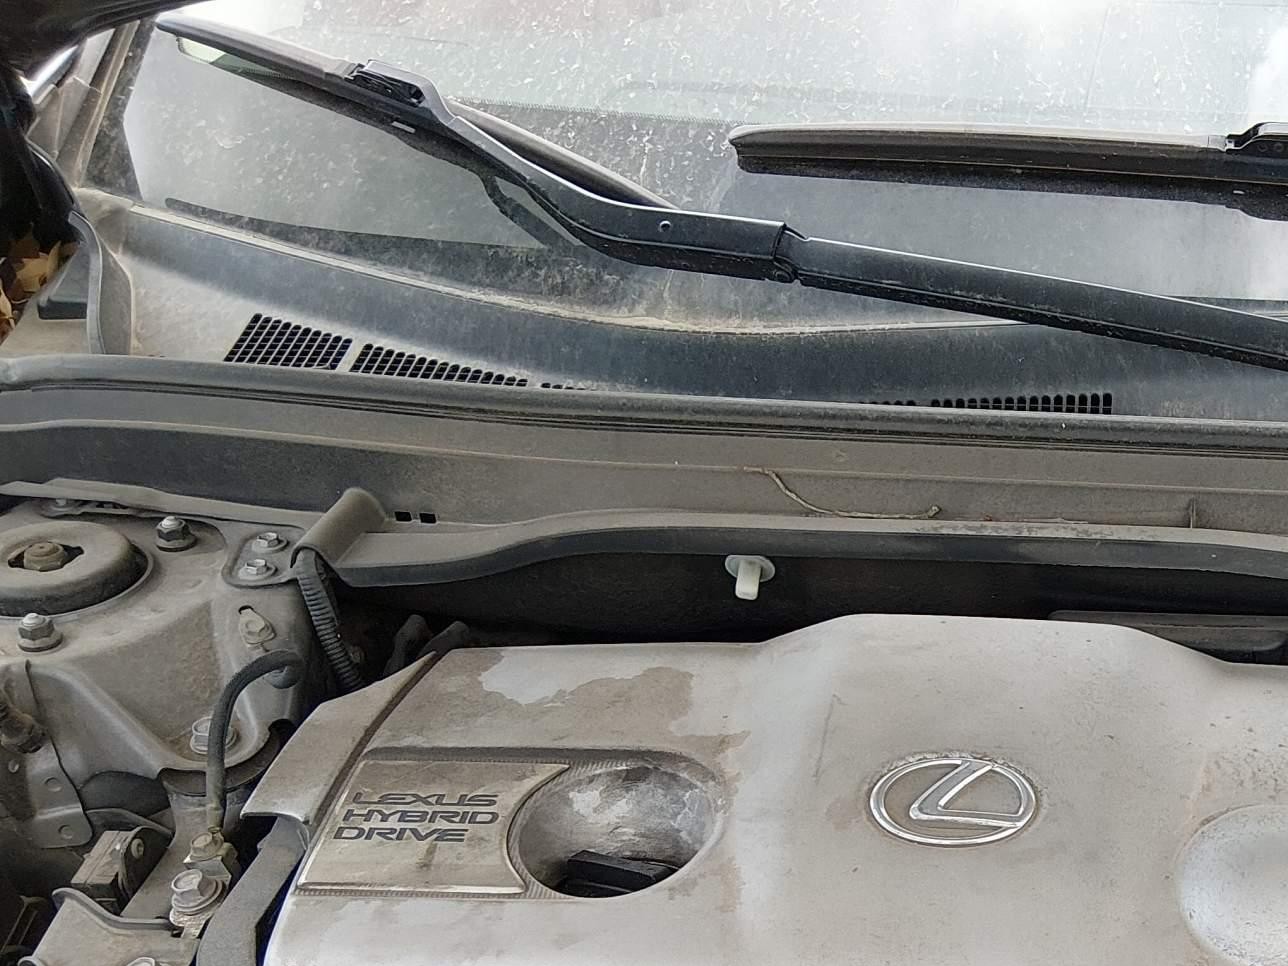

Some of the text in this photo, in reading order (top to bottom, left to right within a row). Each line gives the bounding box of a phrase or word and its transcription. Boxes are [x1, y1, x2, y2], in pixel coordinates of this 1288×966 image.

[352, 792, 499, 806] LEXUS
[342, 809, 500, 825] HYBRID
[333, 826, 469, 842] DRIVE
